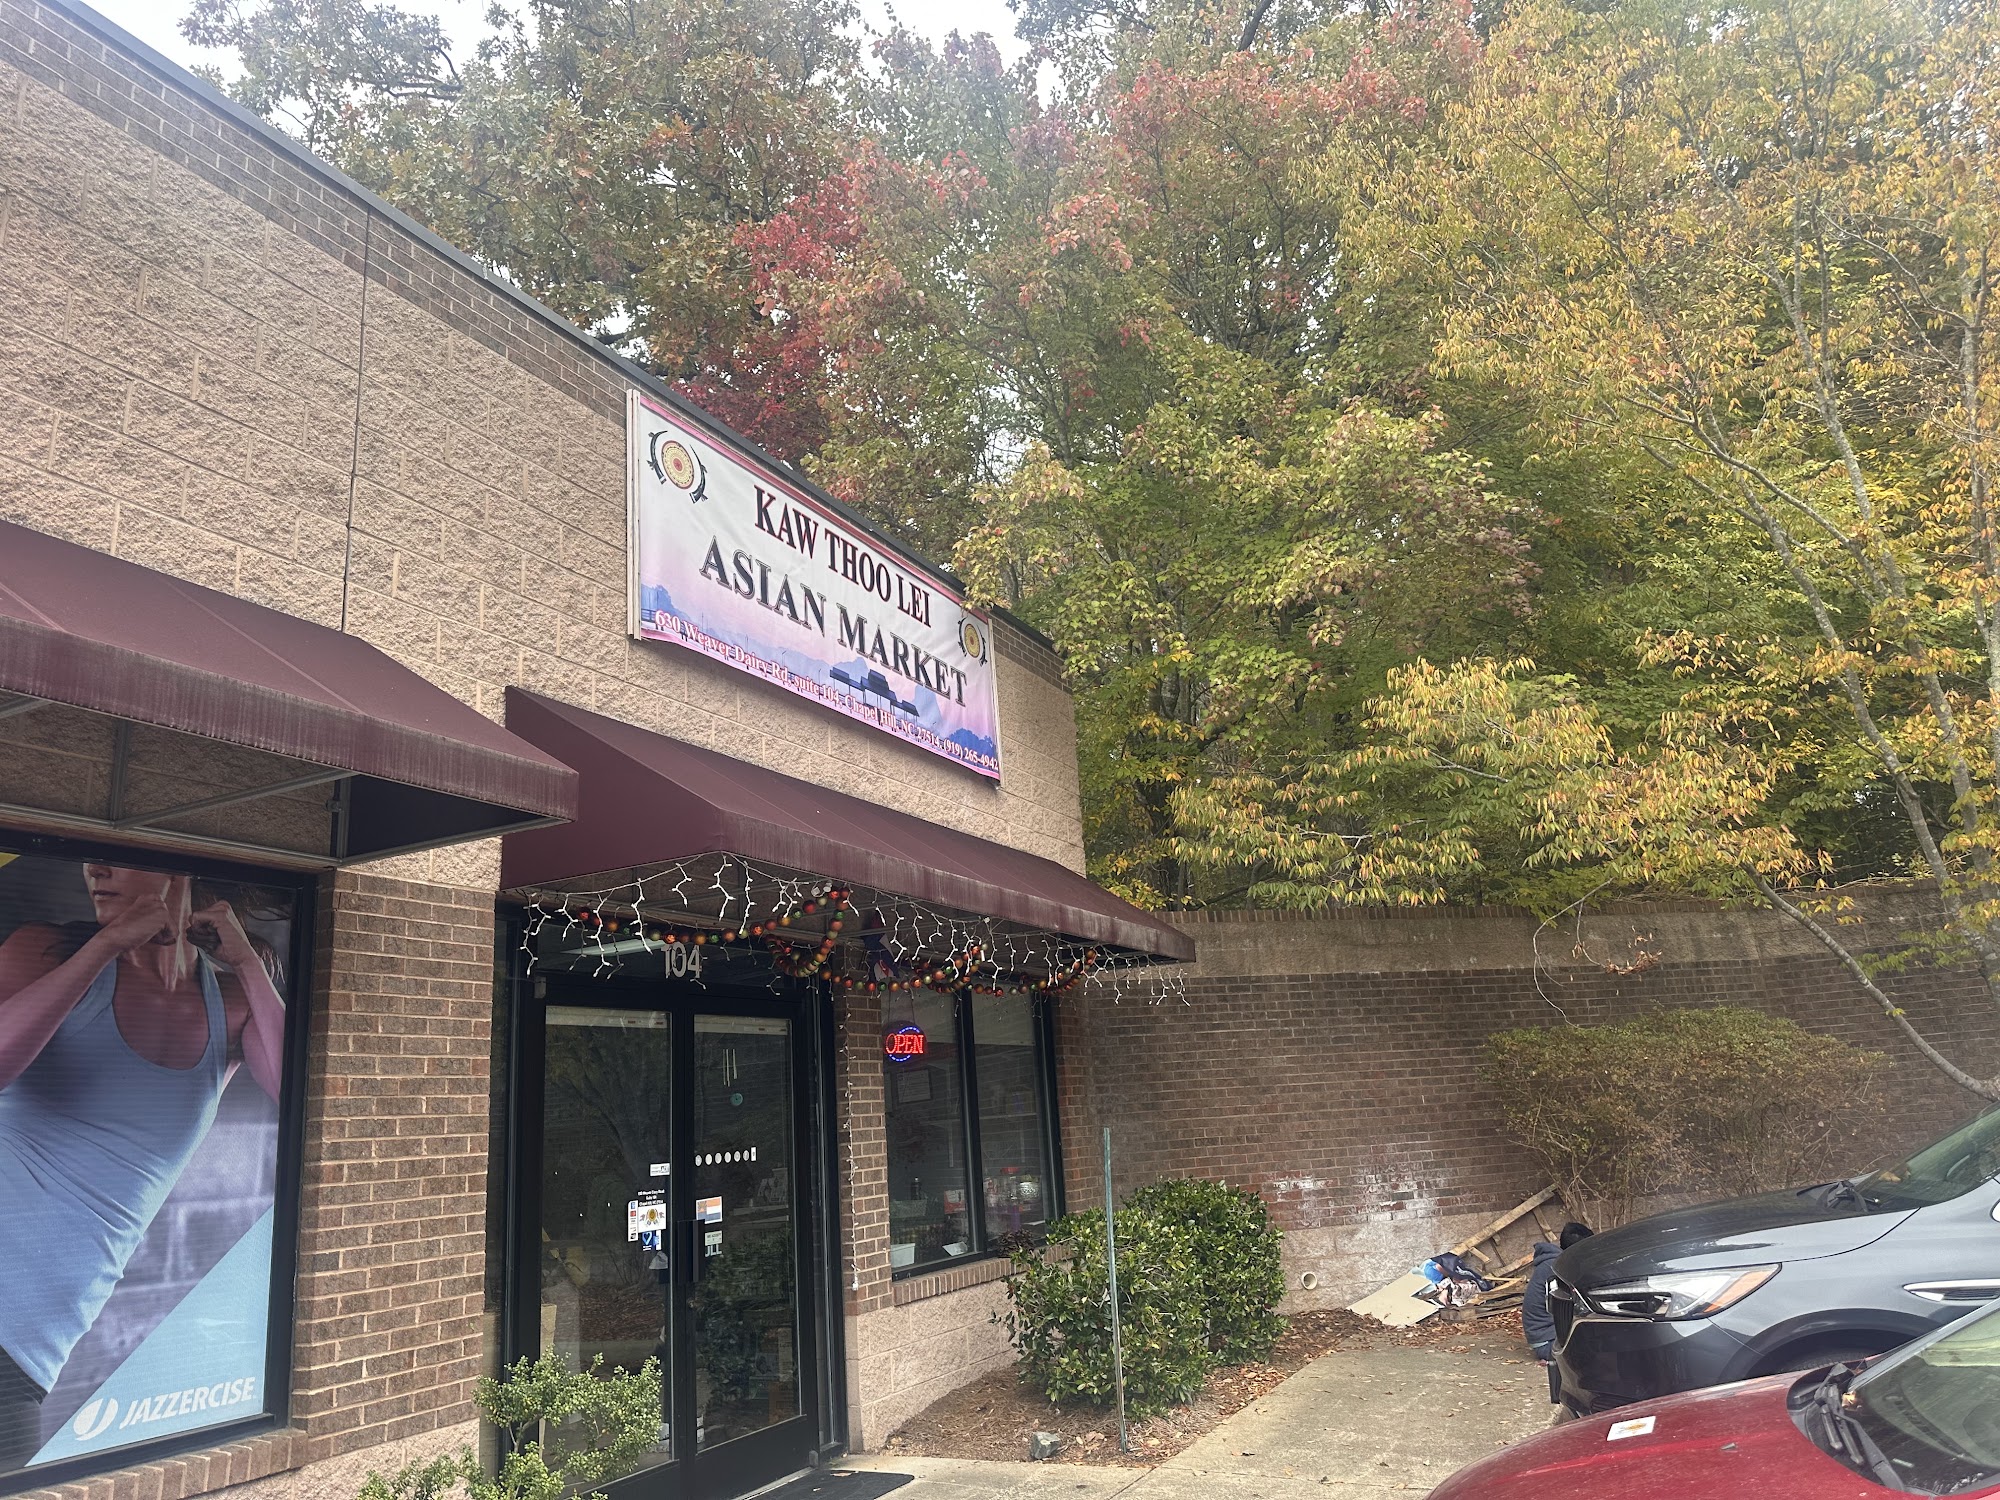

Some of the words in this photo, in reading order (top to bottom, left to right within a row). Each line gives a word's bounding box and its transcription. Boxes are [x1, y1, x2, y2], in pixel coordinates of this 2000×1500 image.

[754, 485, 819, 559] KAW
[825, 528, 891, 602] THOO
[896, 573, 932, 628] LEI
[699, 535, 827, 637] ASIAN
[836, 602, 967, 708] MARKET
[655, 610, 681, 633] 630
[682, 620, 733, 657] Weaver
[734, 644, 769, 678] Dairy
[771, 660, 792, 686] Rd,
[794, 676, 820, 696] suite
[844, 694, 878, 721] Chapel
[901, 720, 915, 736] NC
[943, 737, 964, 759] (919)
[964, 747, 998, 771] 265-4942
[661, 942, 702, 978] 104
[886, 1033, 924, 1054] OPEN
[119, 1377, 256, 1430] JAZZERCISE
